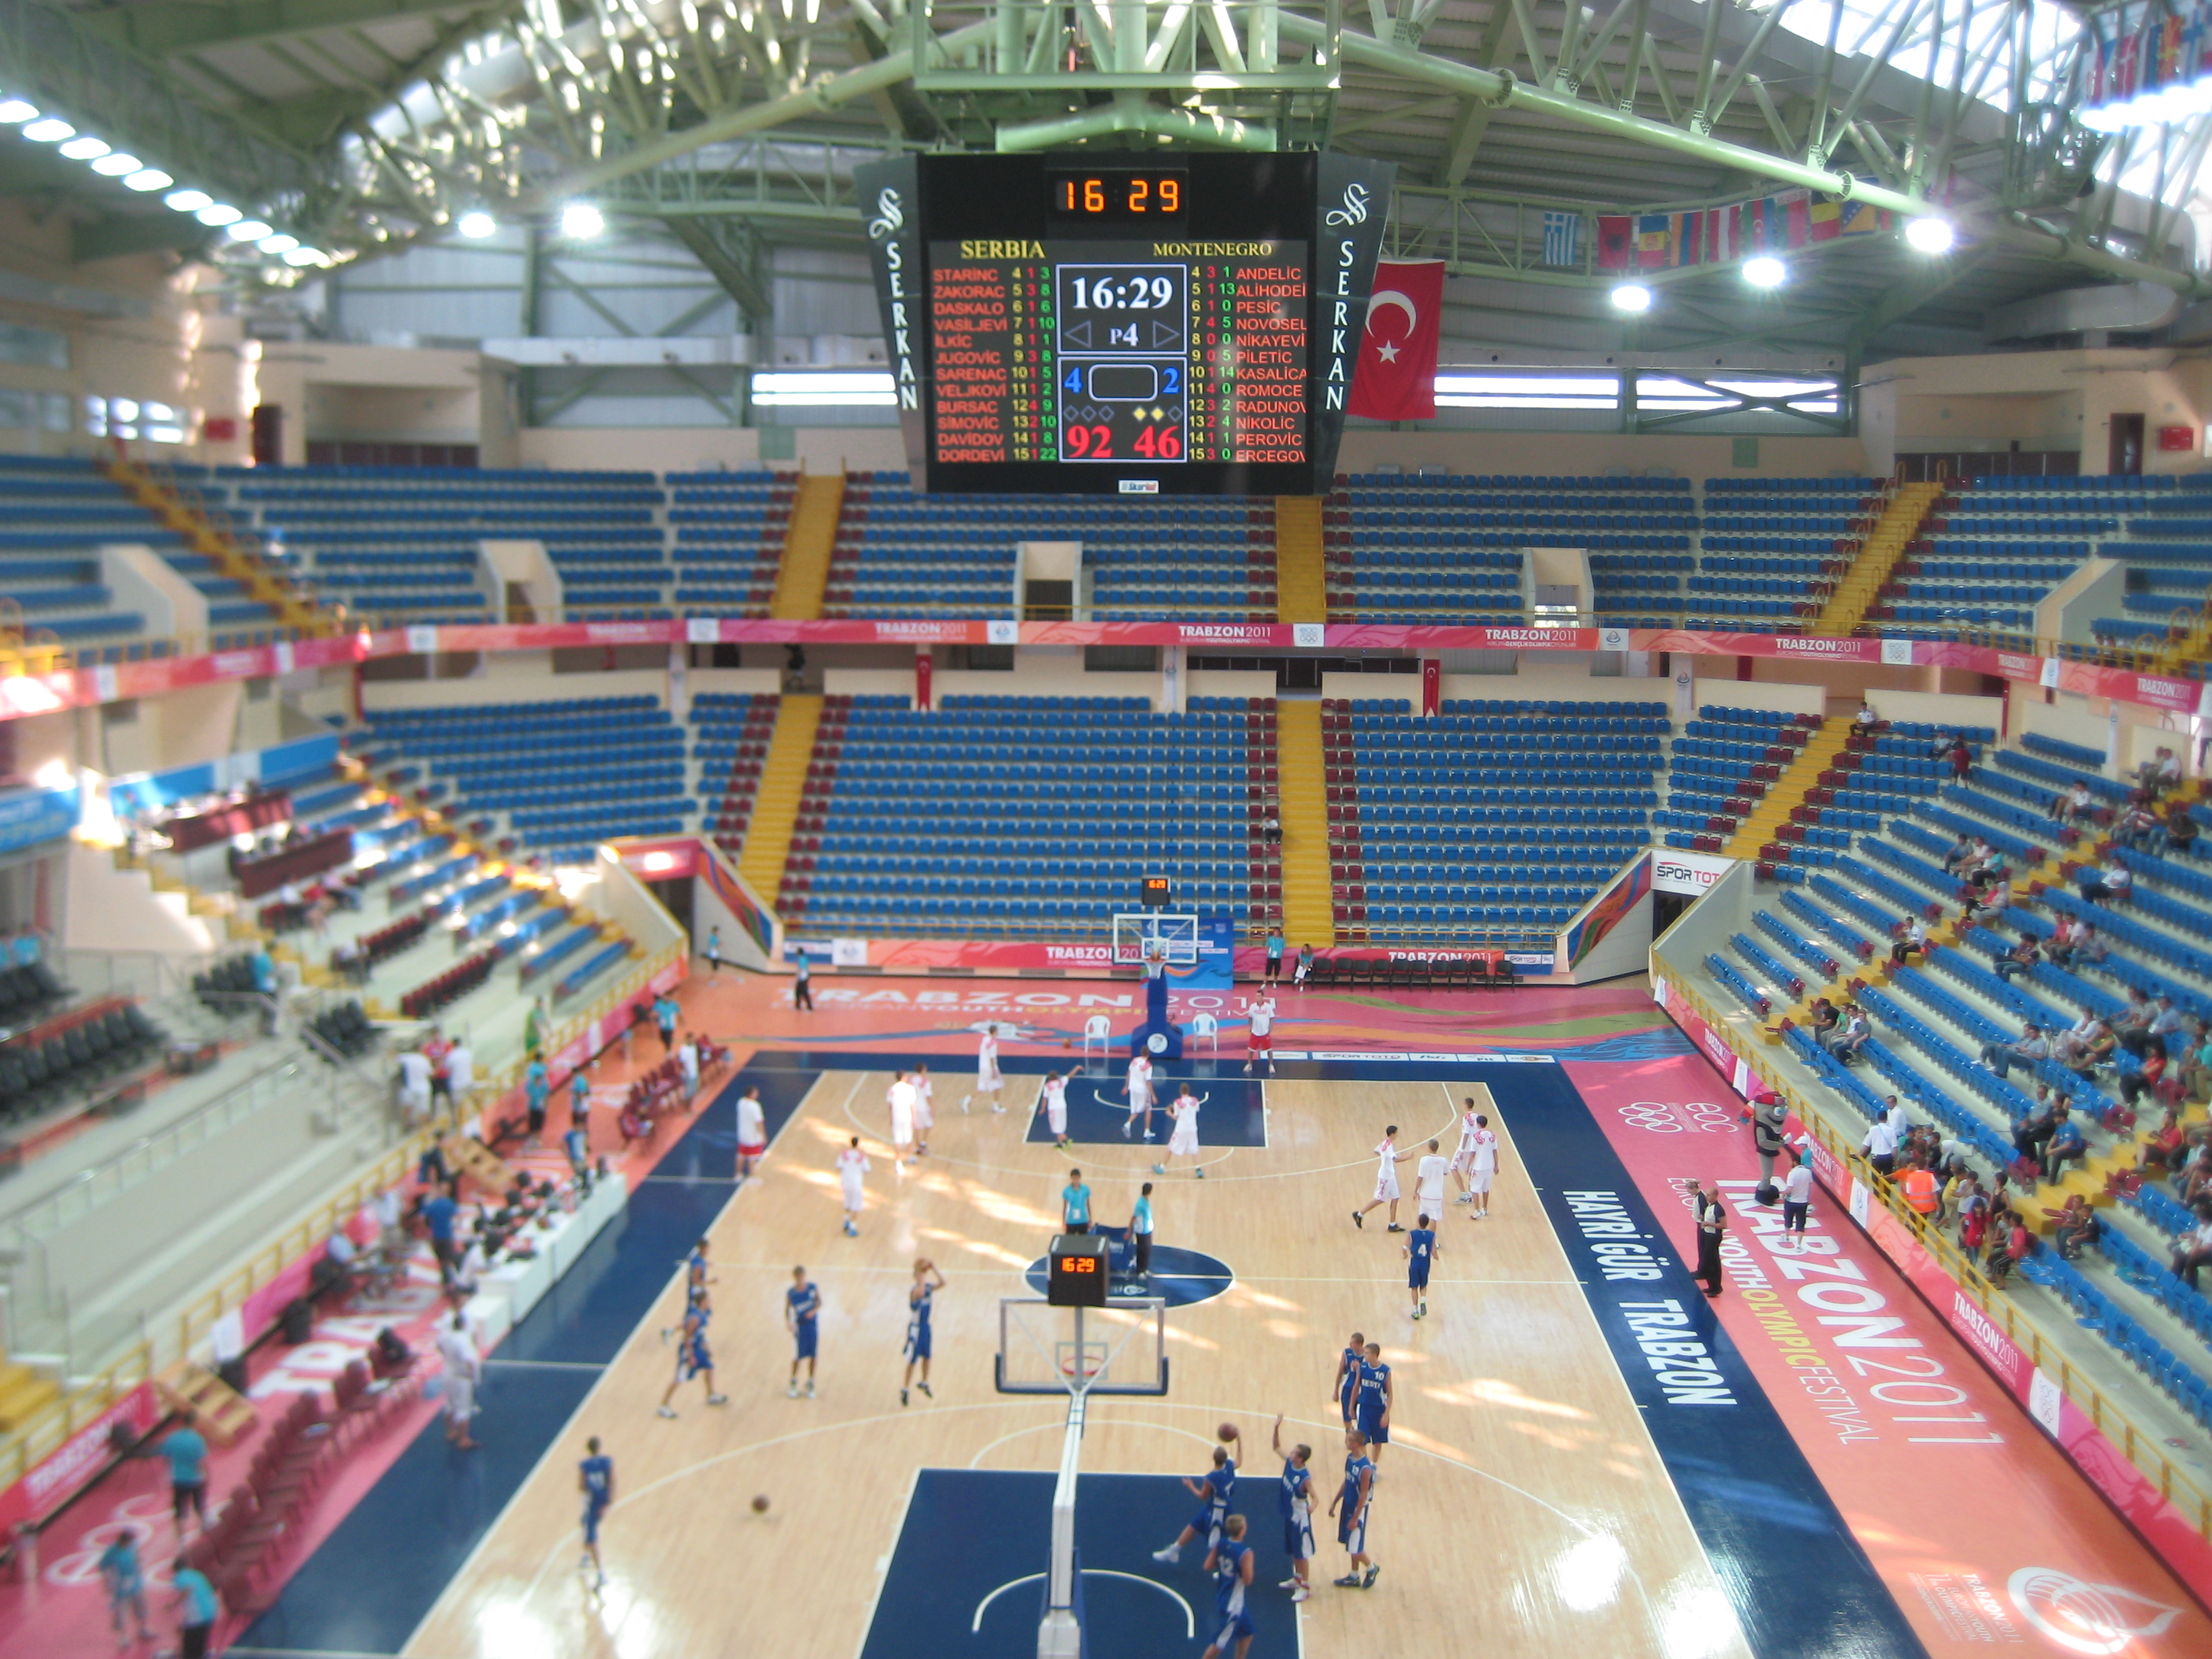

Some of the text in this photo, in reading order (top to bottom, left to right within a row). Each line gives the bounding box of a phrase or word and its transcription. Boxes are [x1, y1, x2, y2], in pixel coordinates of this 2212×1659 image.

[1067, 180, 1179, 212] 16 29
[960, 240, 1046, 259] SERBIA
[1154, 242, 1273, 256] MONTENEGRO
[1012, 267, 1022, 279] 4
[1027, 267, 1035, 278] 1
[1040, 266, 1051, 279] 3
[1192, 266, 1200, 278] 4
[1207, 266, 1216, 278] 3
[1223, 266, 1230, 277] 1
[1012, 283, 1022, 297] 5
[1026, 284, 1037, 296] 3
[1040, 283, 1051, 297] 8
[1072, 276, 1173, 310] 16:29
[1192, 283, 1201, 295] 5
[1208, 283, 1215, 294] 1
[1219, 283, 1236, 295] 13
[1012, 300, 1023, 313] 6
[1028, 300, 1035, 312] 1
[1040, 300, 1051, 313] 6
[1192, 300, 1201, 311] 6
[1208, 300, 1215, 311] 1
[1221, 300, 1232, 312] 0
[886, 241, 919, 411] SERKAN
[1013, 317, 1022, 329] 7
[1028, 317, 1035, 328] 1
[1038, 317, 1055, 330] 10
[1192, 316, 1307, 331] 7 4 5 NOVOSEL
[1326, 240, 1354, 411] SERKAN
[1013, 333, 1024, 346] 8
[1028, 333, 1035, 345] 1
[1043, 333, 1051, 345] 1
[1192, 333, 1201, 345] 8
[1206, 333, 1216, 345] 0
[1221, 333, 1231, 345] 0
[1013, 350, 1024, 362] 9
[1028, 350, 1038, 362] 3
[1041, 349, 1052, 362] 8
[1192, 349, 1201, 361] 9
[1206, 349, 1216, 361] 0
[1223, 349, 1231, 361] 5
[1012, 367, 1028, 379] 10
[1029, 367, 1037, 378] 1
[1042, 367, 1052, 379] 5
[1190, 367, 1205, 378] 10
[1208, 367, 1215, 377] 1
[1220, 367, 1235, 377] 14
[1064, 367, 1083, 394] 4
[1162, 367, 1180, 394] 2
[1012, 383, 1028, 395] 11
[1030, 383, 1037, 395] 1
[1042, 383, 1053, 395] 2
[1190, 382, 1303, 397] 11 4 0 ROMOCE
[1012, 400, 1028, 412] 12
[1028, 400, 1038, 410] 4
[1042, 399, 1053, 412] 9
[1190, 399, 1205, 411] 12
[1207, 399, 1216, 411] 3
[1223, 399, 1231, 411] 2
[1012, 415, 1029, 428] 13
[1029, 415, 1038, 428] 2
[1040, 415, 1056, 428] 10
[1190, 415, 1205, 427] 13
[1207, 415, 1215, 428] 2
[1222, 415, 1231, 427] 4
[1013, 432, 1028, 444] 14
[1030, 432, 1038, 444] 1
[1043, 432, 1053, 444] 8
[1066, 425, 1181, 459] 92 46
[1190, 432, 1205, 443] 14
[1208, 432, 1214, 443] 1
[1224, 432, 1230, 444] 1
[1013, 448, 1030, 461] 15
[1031, 449, 1038, 459] 1
[1039, 448, 1057, 461] 22
[1190, 448, 1205, 459] 15
[1207, 448, 1216, 459] 3
[1221, 448, 1231, 459] 0
[1657, 866, 1691, 881] SPOR
[1694, 871, 1720, 884] TOT
[1418, 1243, 1428, 1257] 4
[1590, 1243, 1671, 1280] GÜR
[1619, 1299, 1737, 1405] TRABZON
[1375, 1371, 1385, 1381] 10
